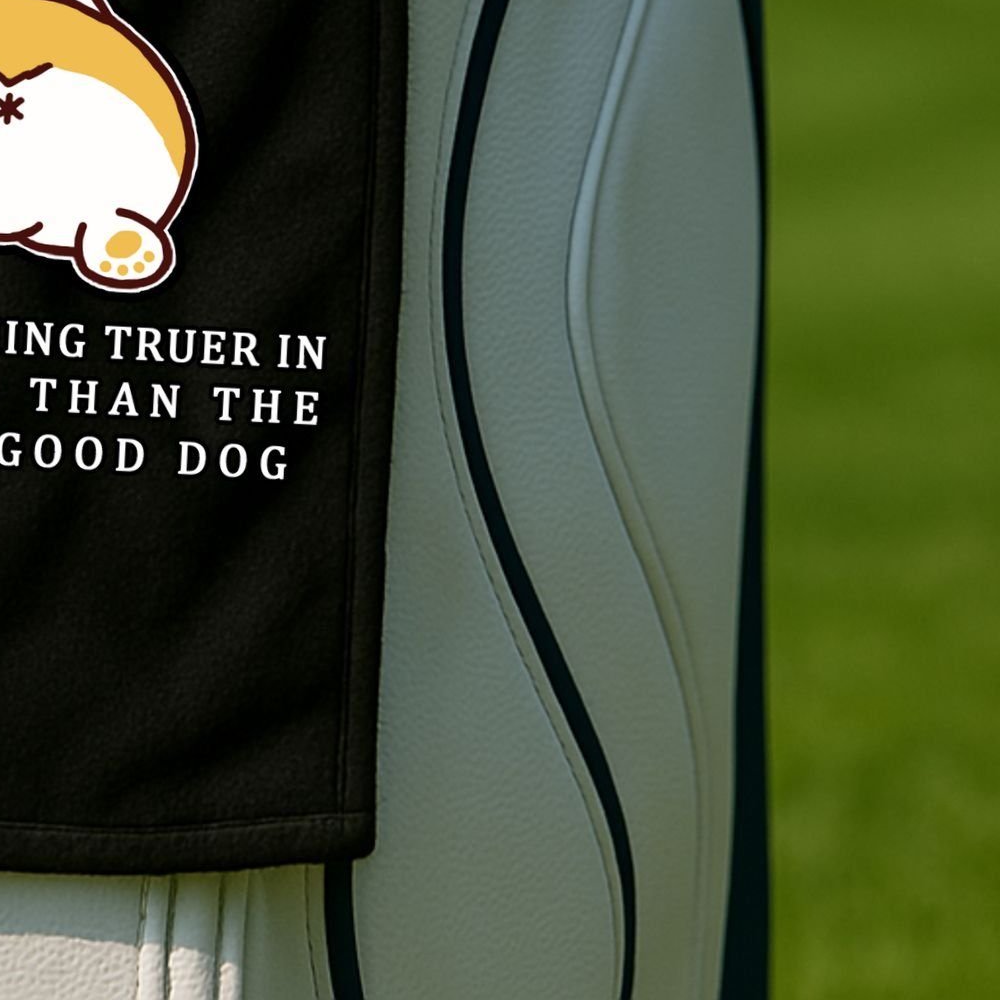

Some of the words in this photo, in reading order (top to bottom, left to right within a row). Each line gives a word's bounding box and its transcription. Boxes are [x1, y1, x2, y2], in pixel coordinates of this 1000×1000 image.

[104, 325, 261, 367] TRUER
[277, 333, 327, 370] IN
[29, 377, 181, 419] THAN
[212, 386, 319, 426] THE
[177, 440, 287, 480] DOG
